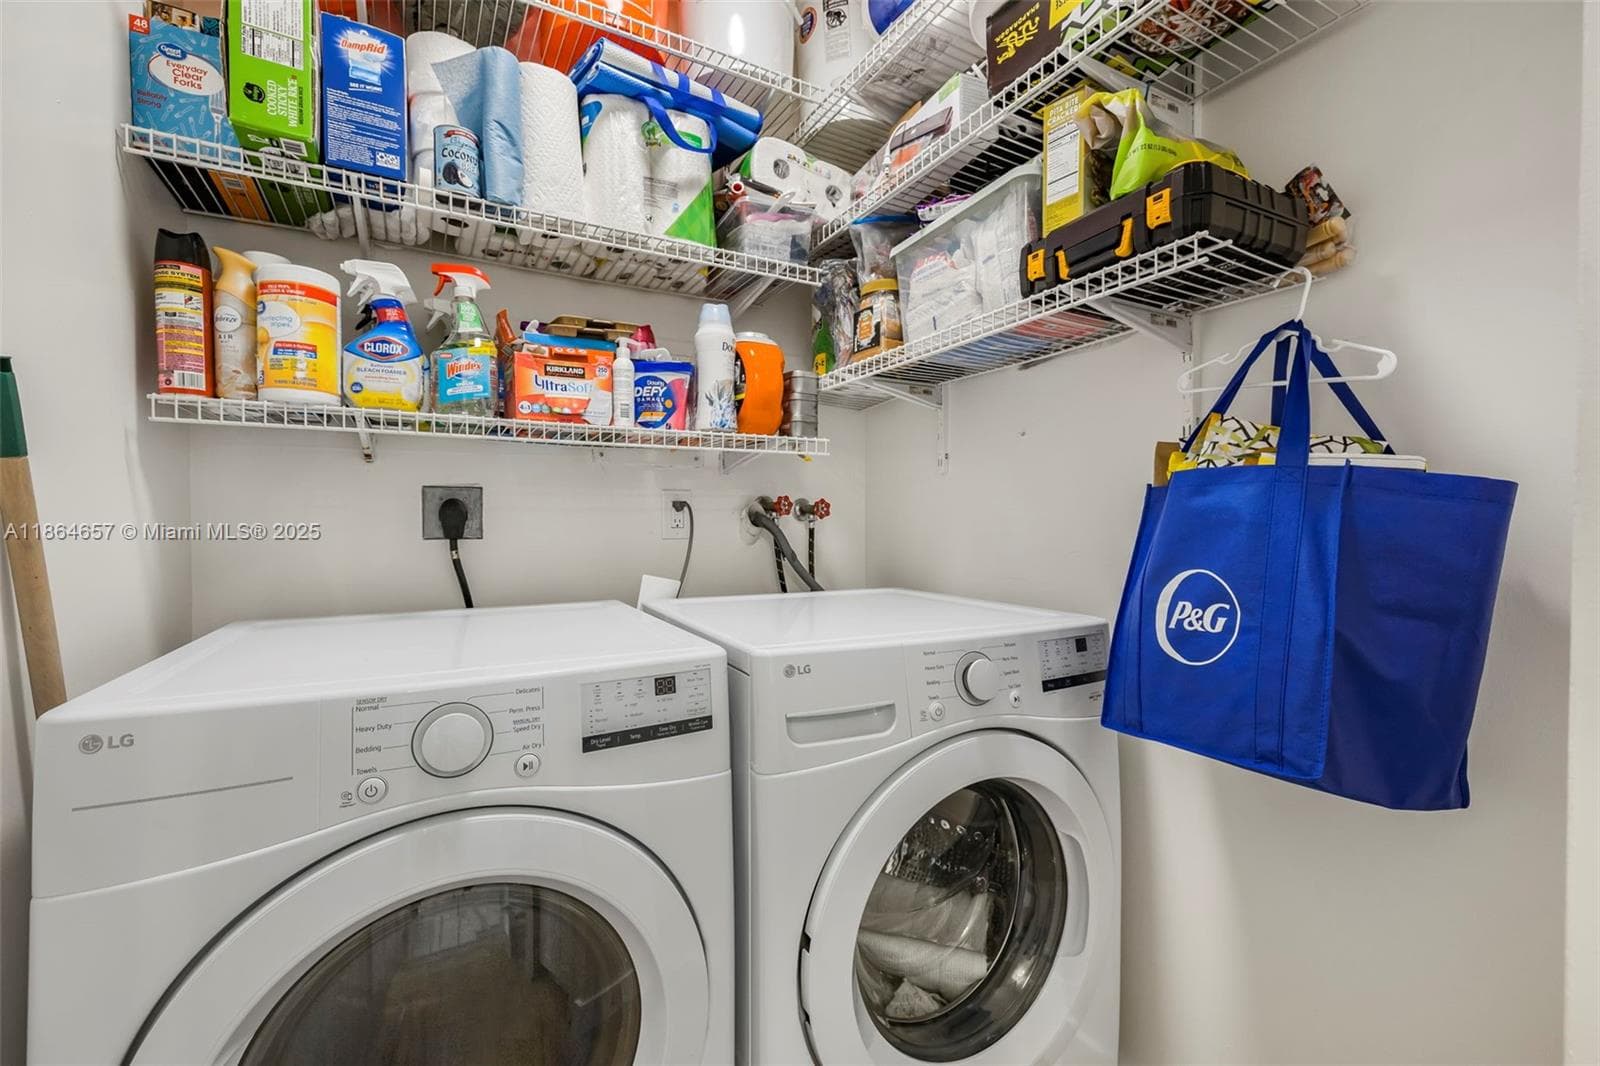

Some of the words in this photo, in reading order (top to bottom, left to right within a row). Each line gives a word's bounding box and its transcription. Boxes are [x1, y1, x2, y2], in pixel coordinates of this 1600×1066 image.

[133, 18, 148, 29] 48
[341, 39, 385, 55] DampRid
[166, 60, 209, 77] Everyday
[172, 68, 204, 82] Clear
[173, 77, 203, 91] Forks
[266, 79, 277, 116] COOKED
[277, 84, 288, 117] STICKY
[287, 99, 298, 128] WHITE
[363, 342, 403, 355] CLOROX
[447, 361, 481, 379] Windex
[546, 365, 584, 375] KIRKLAND
[634, 386, 668, 397] DEFY
[1168, 600, 1231, 633] P&G
[797, 664, 811, 675] LG
[355, 703, 379, 712] Normal
[355, 725, 375, 733] Heavy
[376, 723, 392, 731] Duty
[513, 725, 530, 733] Speed
[531, 723, 541, 731] Dry
[107, 733, 135, 749] LG
[355, 745, 382, 754] Bedding
[356, 766, 378, 775] Towels
